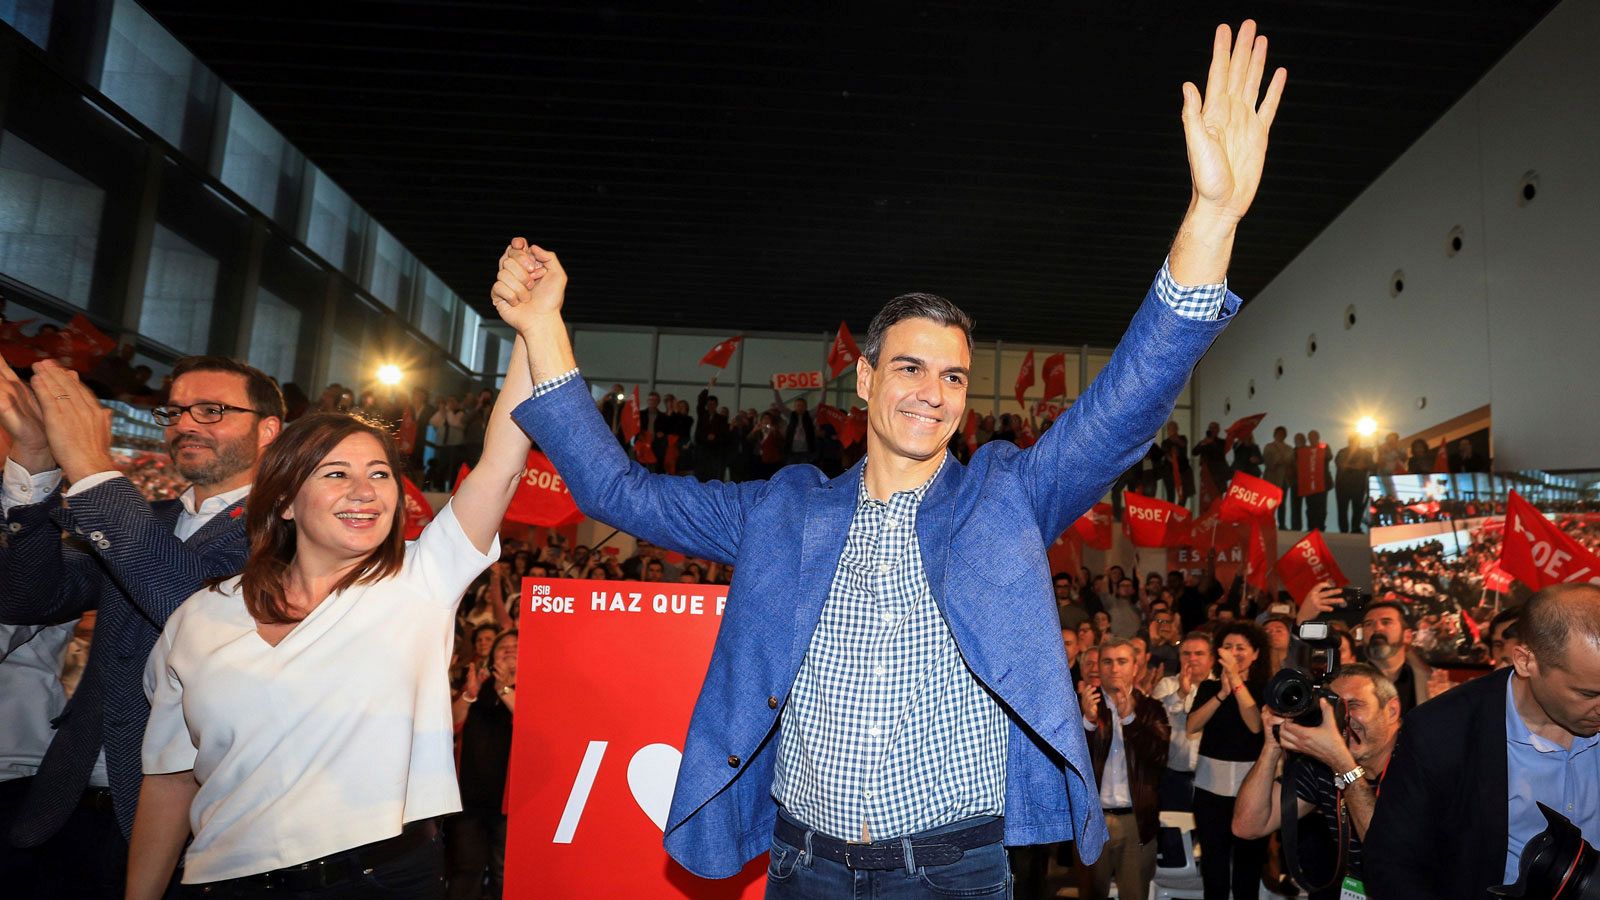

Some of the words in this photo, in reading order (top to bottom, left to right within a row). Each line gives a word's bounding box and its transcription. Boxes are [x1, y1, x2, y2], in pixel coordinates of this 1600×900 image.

[776, 372, 820, 389] PSOE
[1228, 485, 1259, 505] PSOE
[1129, 505, 1163, 523] PSOE
[1179, 545, 1242, 562] ESAÑ
[1296, 539, 1325, 575] PSOE
[532, 584, 551, 595] PSIB
[531, 596, 575, 614] PSOE
[591, 591, 642, 613] HAZ
[652, 593, 705, 615] QUE
